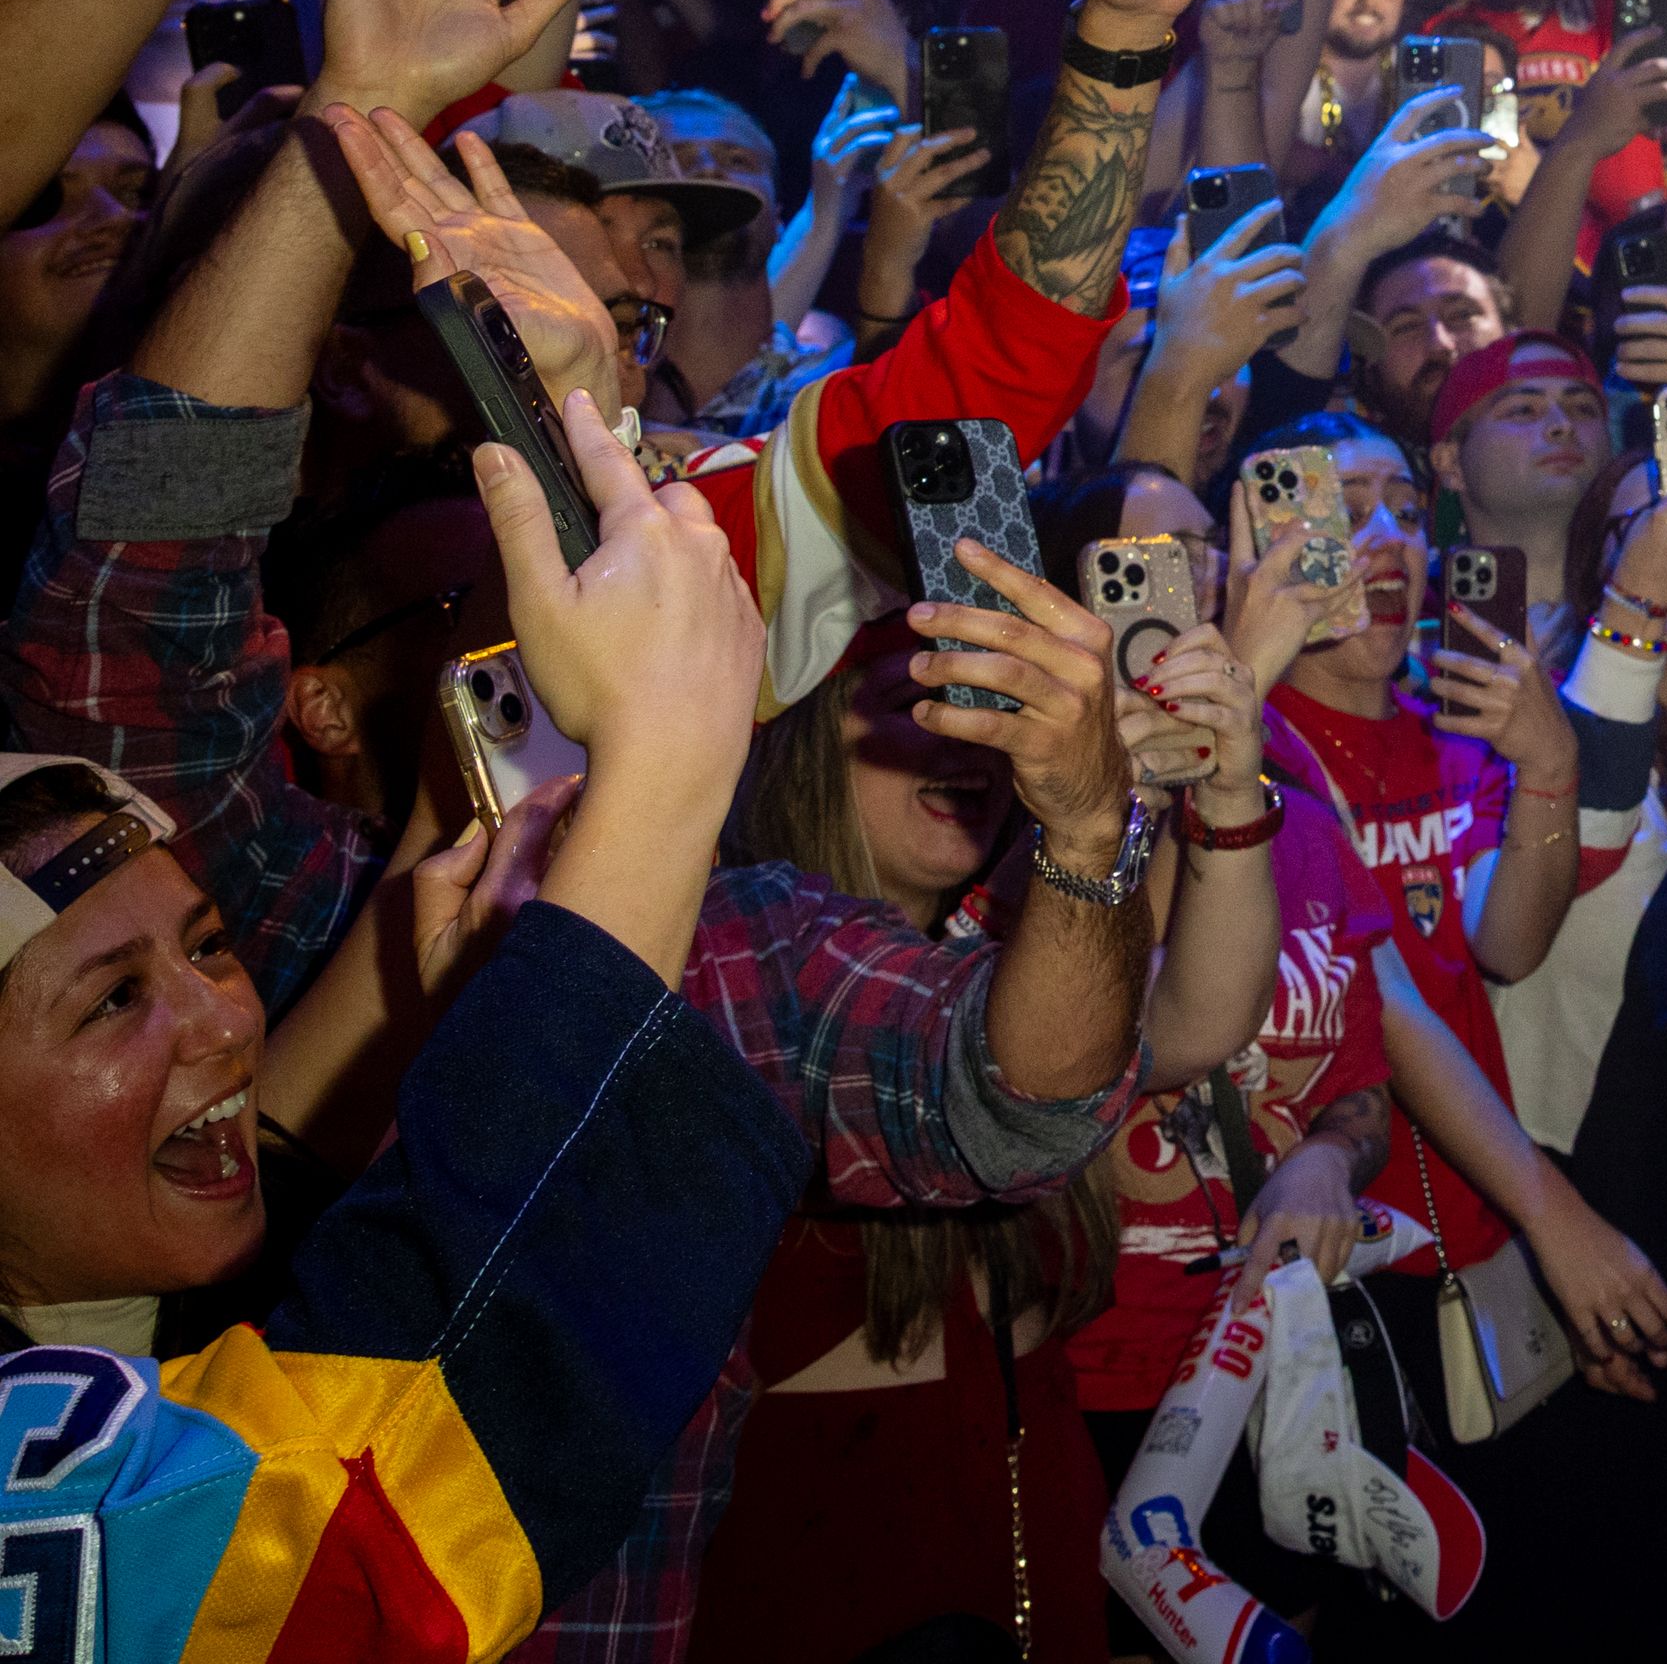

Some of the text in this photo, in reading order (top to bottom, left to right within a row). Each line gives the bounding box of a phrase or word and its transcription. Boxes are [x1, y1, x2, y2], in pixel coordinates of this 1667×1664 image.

[1212, 1320, 1265, 1381] GO
[1305, 1492, 1339, 1558] ers
[1147, 1579, 1198, 1651] Hunter
